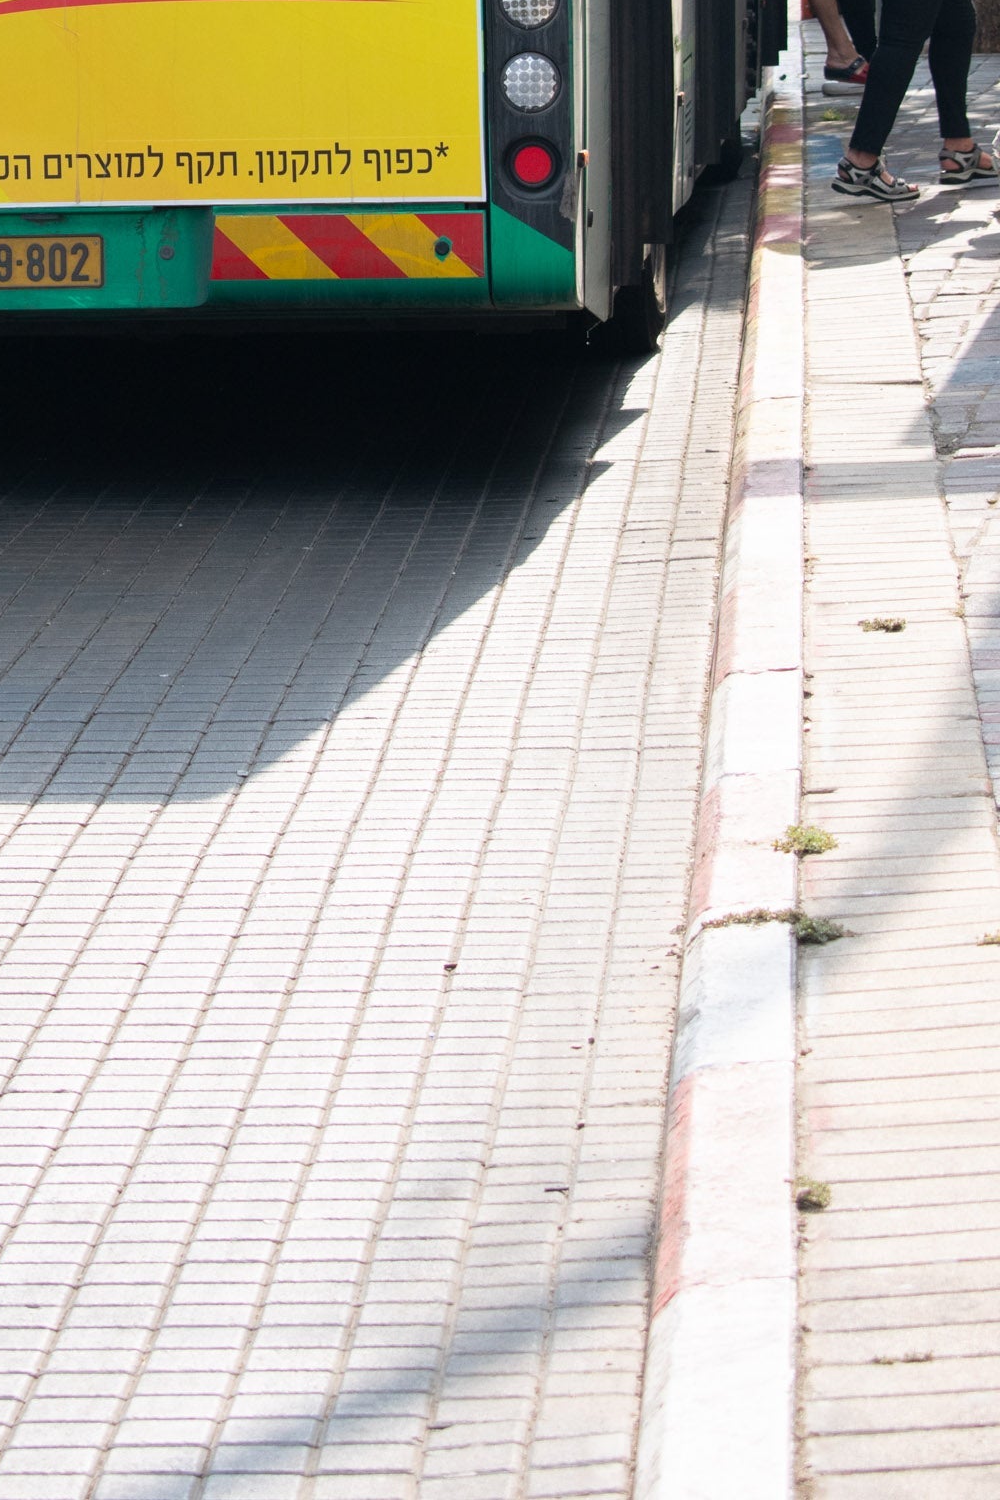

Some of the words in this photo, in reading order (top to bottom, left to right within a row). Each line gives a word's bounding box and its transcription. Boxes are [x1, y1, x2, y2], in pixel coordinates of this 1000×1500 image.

[43, 145, 164, 180] למוצרים
[176, 152, 238, 185] תקף
[248, 143, 351, 184] לתקנון.
